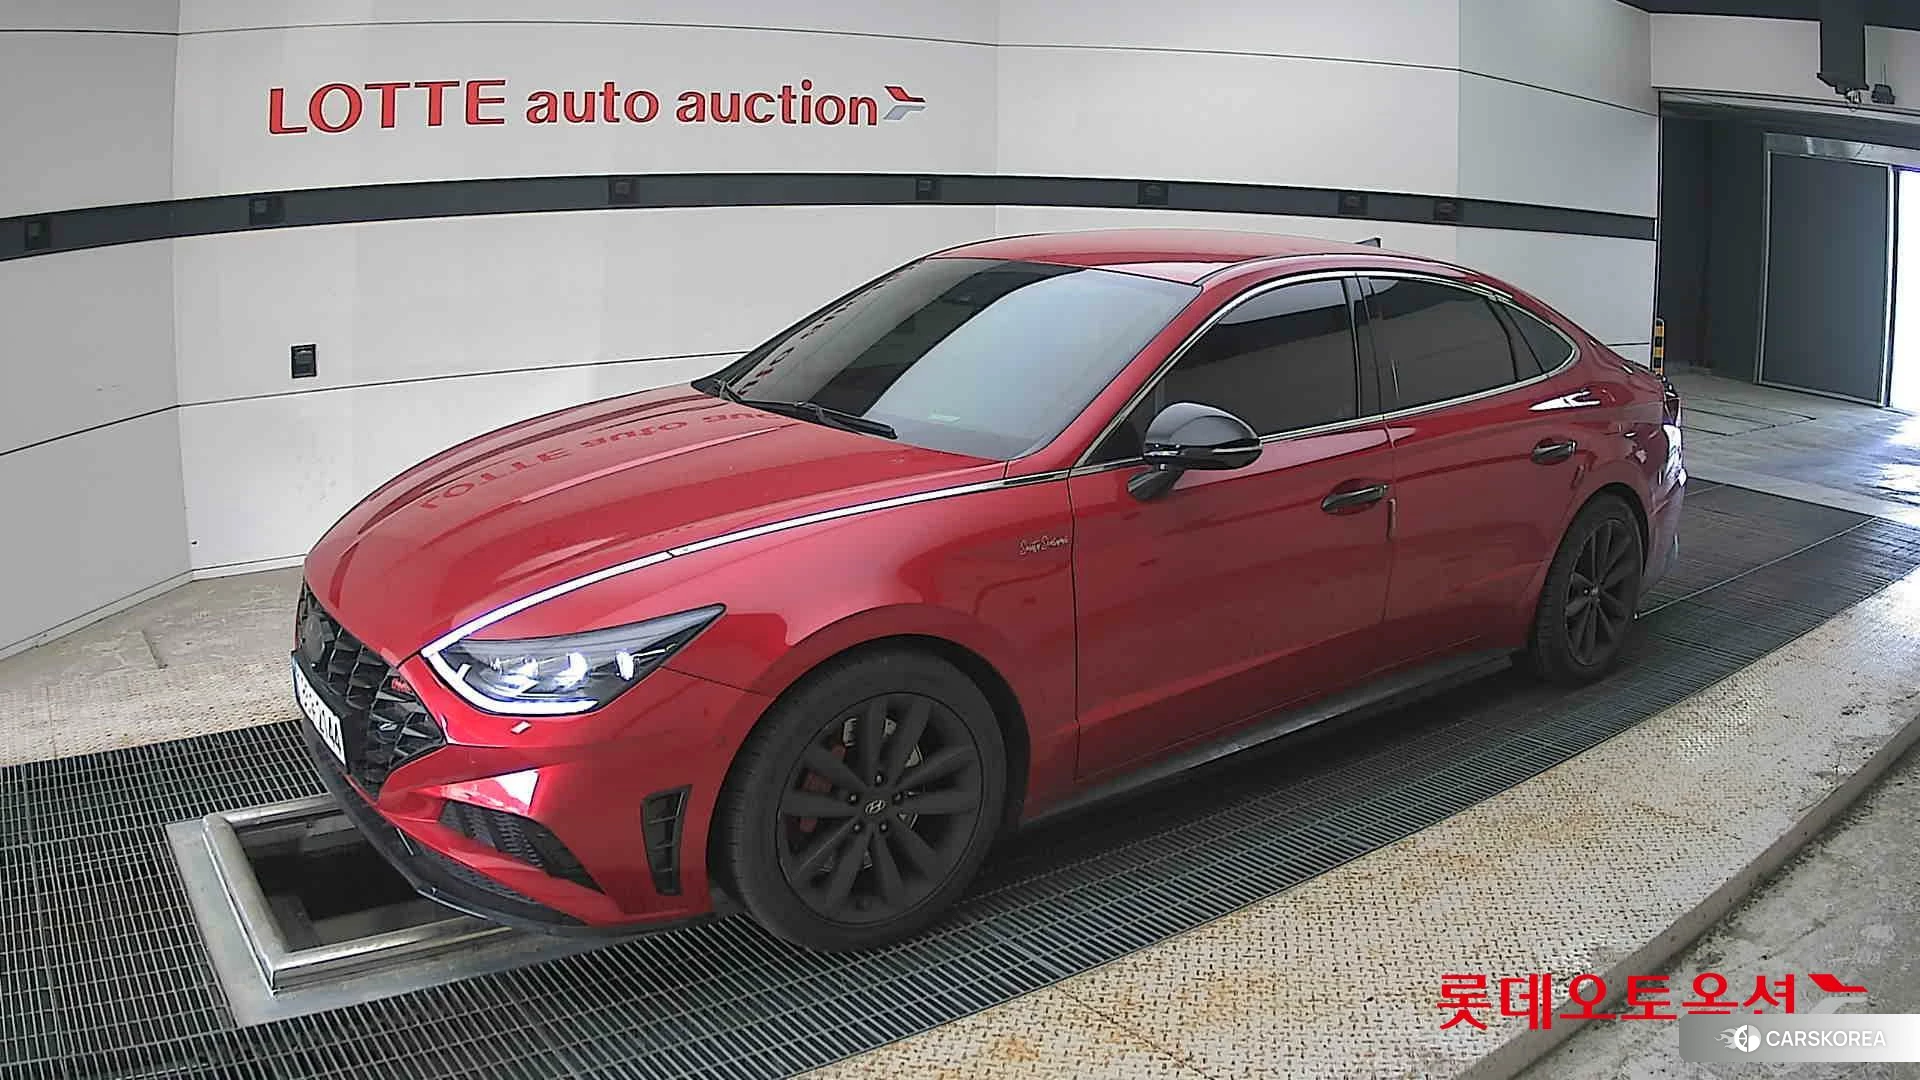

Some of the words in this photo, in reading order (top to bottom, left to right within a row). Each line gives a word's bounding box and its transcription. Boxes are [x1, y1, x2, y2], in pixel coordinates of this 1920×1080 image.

[269, 79, 506, 135] LOTTE
[526, 81, 660, 125] auto
[676, 79, 879, 127] auction
